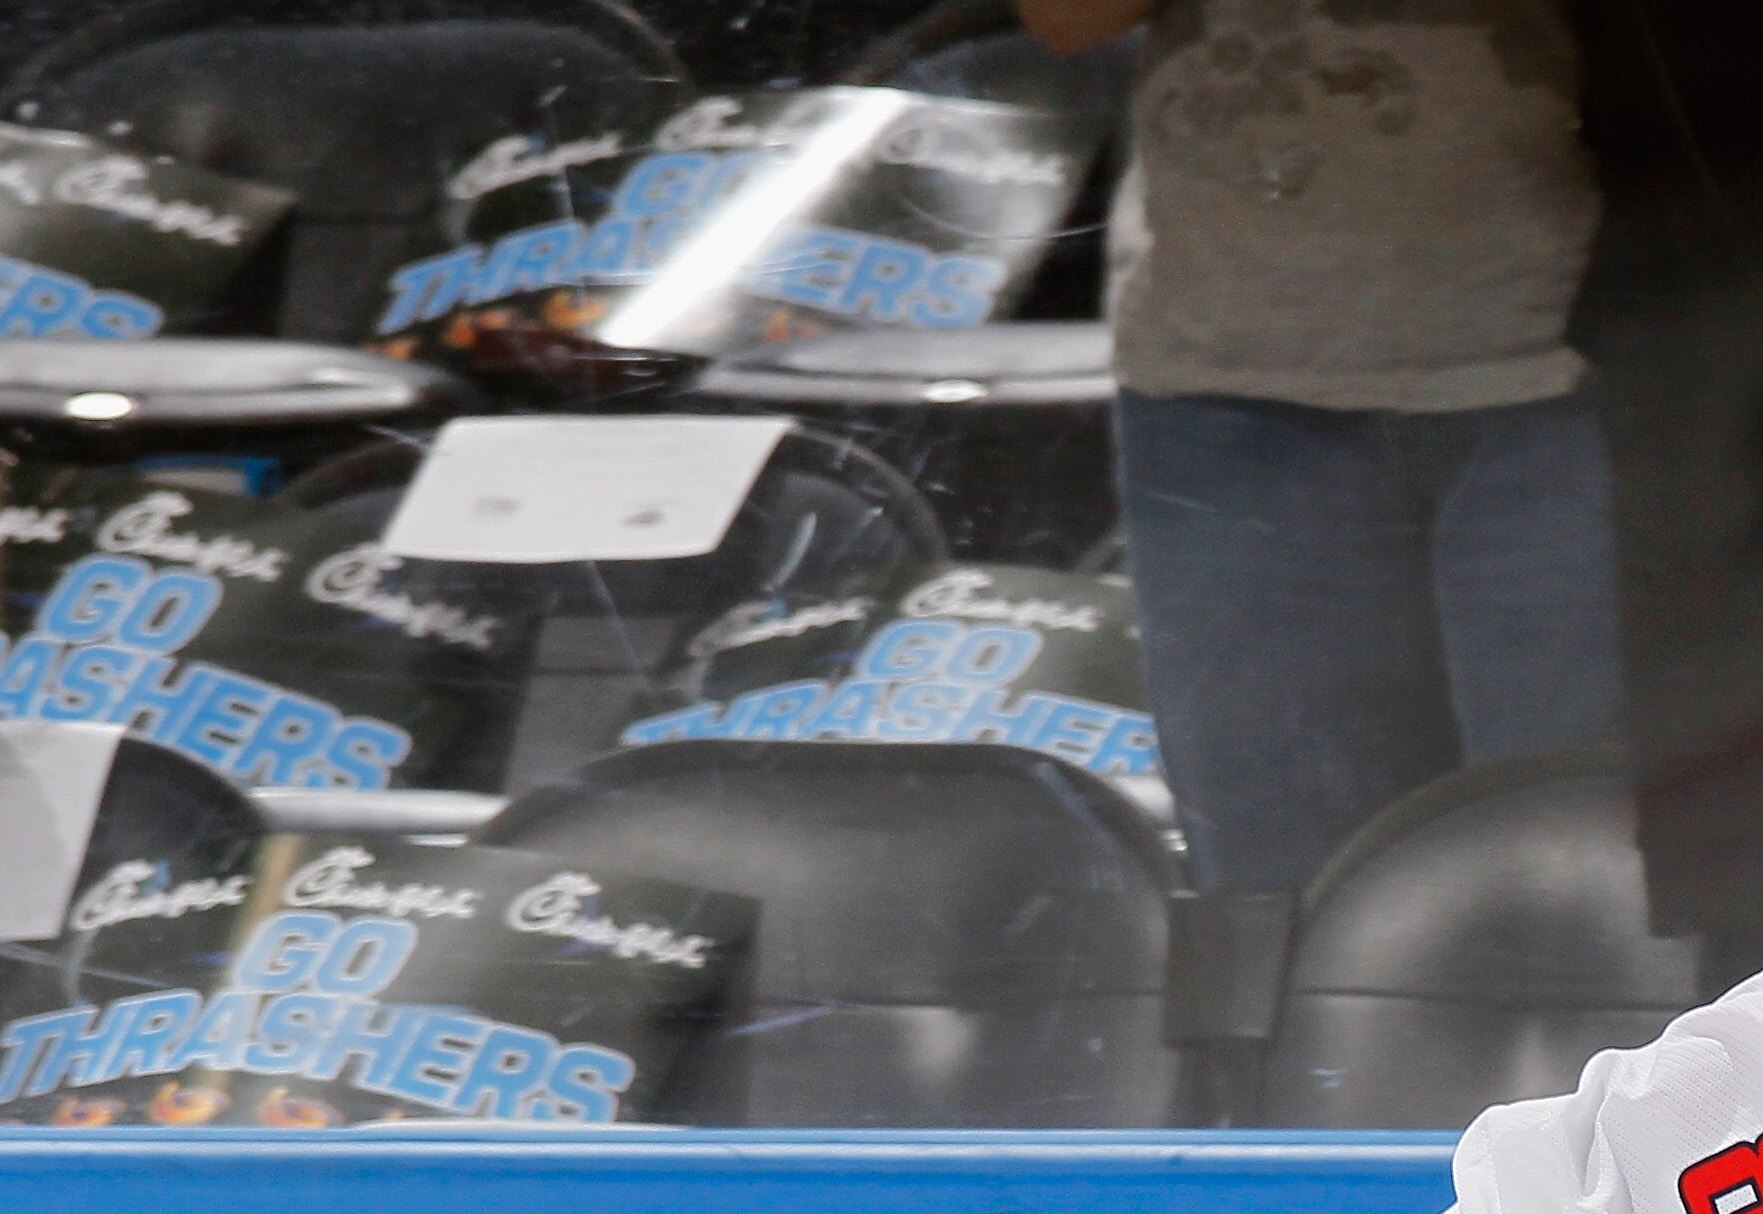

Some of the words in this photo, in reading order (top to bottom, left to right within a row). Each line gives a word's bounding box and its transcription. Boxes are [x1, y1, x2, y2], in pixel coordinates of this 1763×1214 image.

[378, 215, 1008, 334] THRAERS
[36, 552, 224, 656] GO
[857, 618, 1044, 689] GO
[0, 630, 412, 792] ASHERS
[234, 908, 418, 996] GO
[0, 985, 637, 1124] THRASHERS
